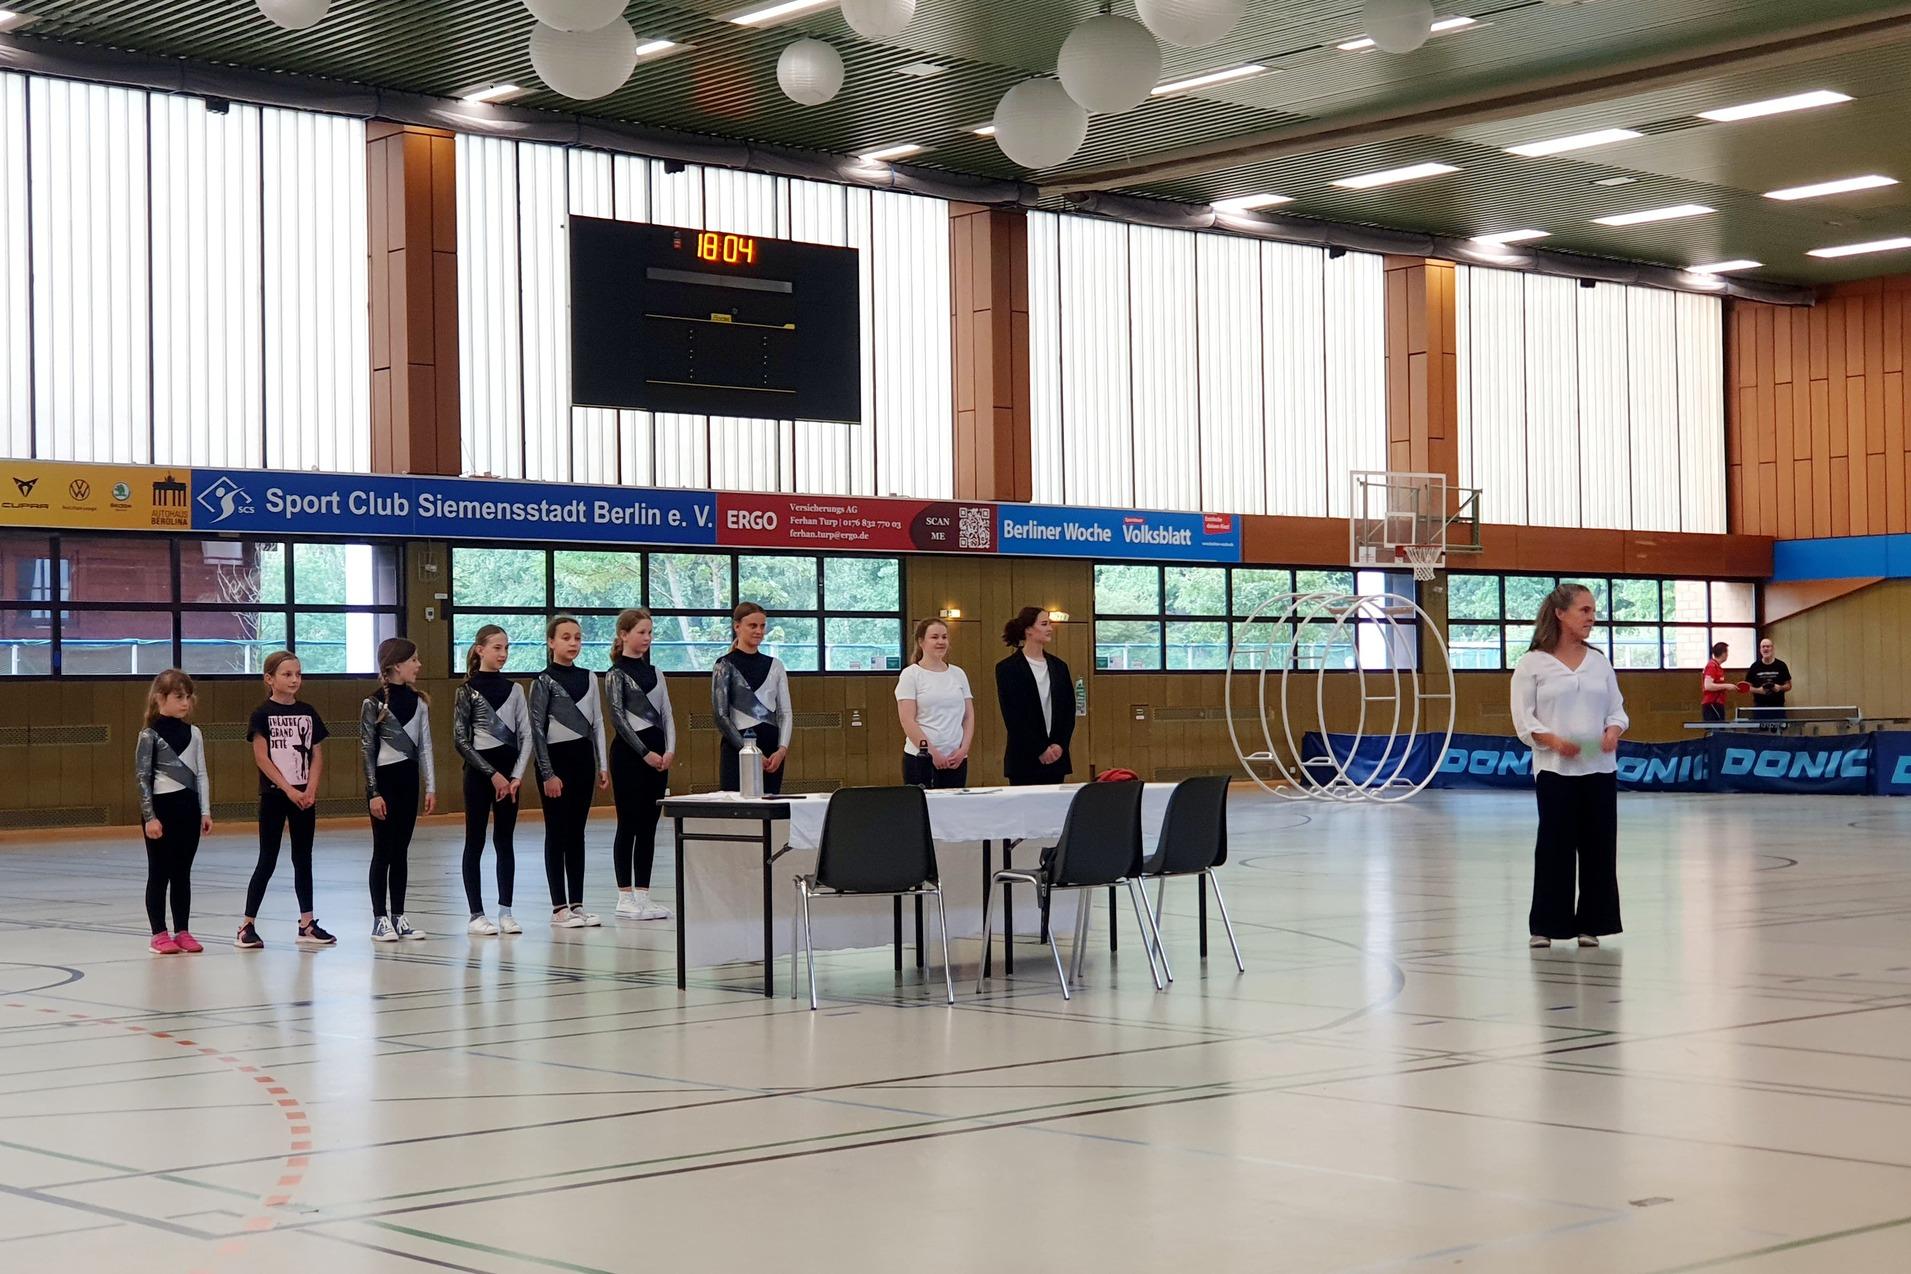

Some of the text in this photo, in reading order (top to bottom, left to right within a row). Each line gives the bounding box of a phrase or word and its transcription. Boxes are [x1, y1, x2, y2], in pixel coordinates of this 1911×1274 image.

[151, 509, 188, 518] AUTOHAUS
[238, 506, 255, 514] SCS
[265, 488, 713, 528] Sport Club Siemensstadt Berlin e. V.
[789, 503, 858, 514] Versicherungs AG
[151, 517, 188, 526] BEROLINA
[727, 510, 777, 530] ERGO
[789, 516, 902, 530] Ferhan Turp 0176 832 770 03
[925, 517, 950, 526] SCAN
[789, 529, 869, 541] ferhan.turp@ergo.de
[931, 532, 946, 540] ME
[1003, 519, 1112, 543] Berliner Woche
[1122, 525, 1192, 546] Volksblatt
[270, 727, 294, 738] GRAND
[1437, 748, 1535, 775] DON
[1721, 748, 1870, 778] DONIC
[1616, 754, 1709, 783] ONIC
